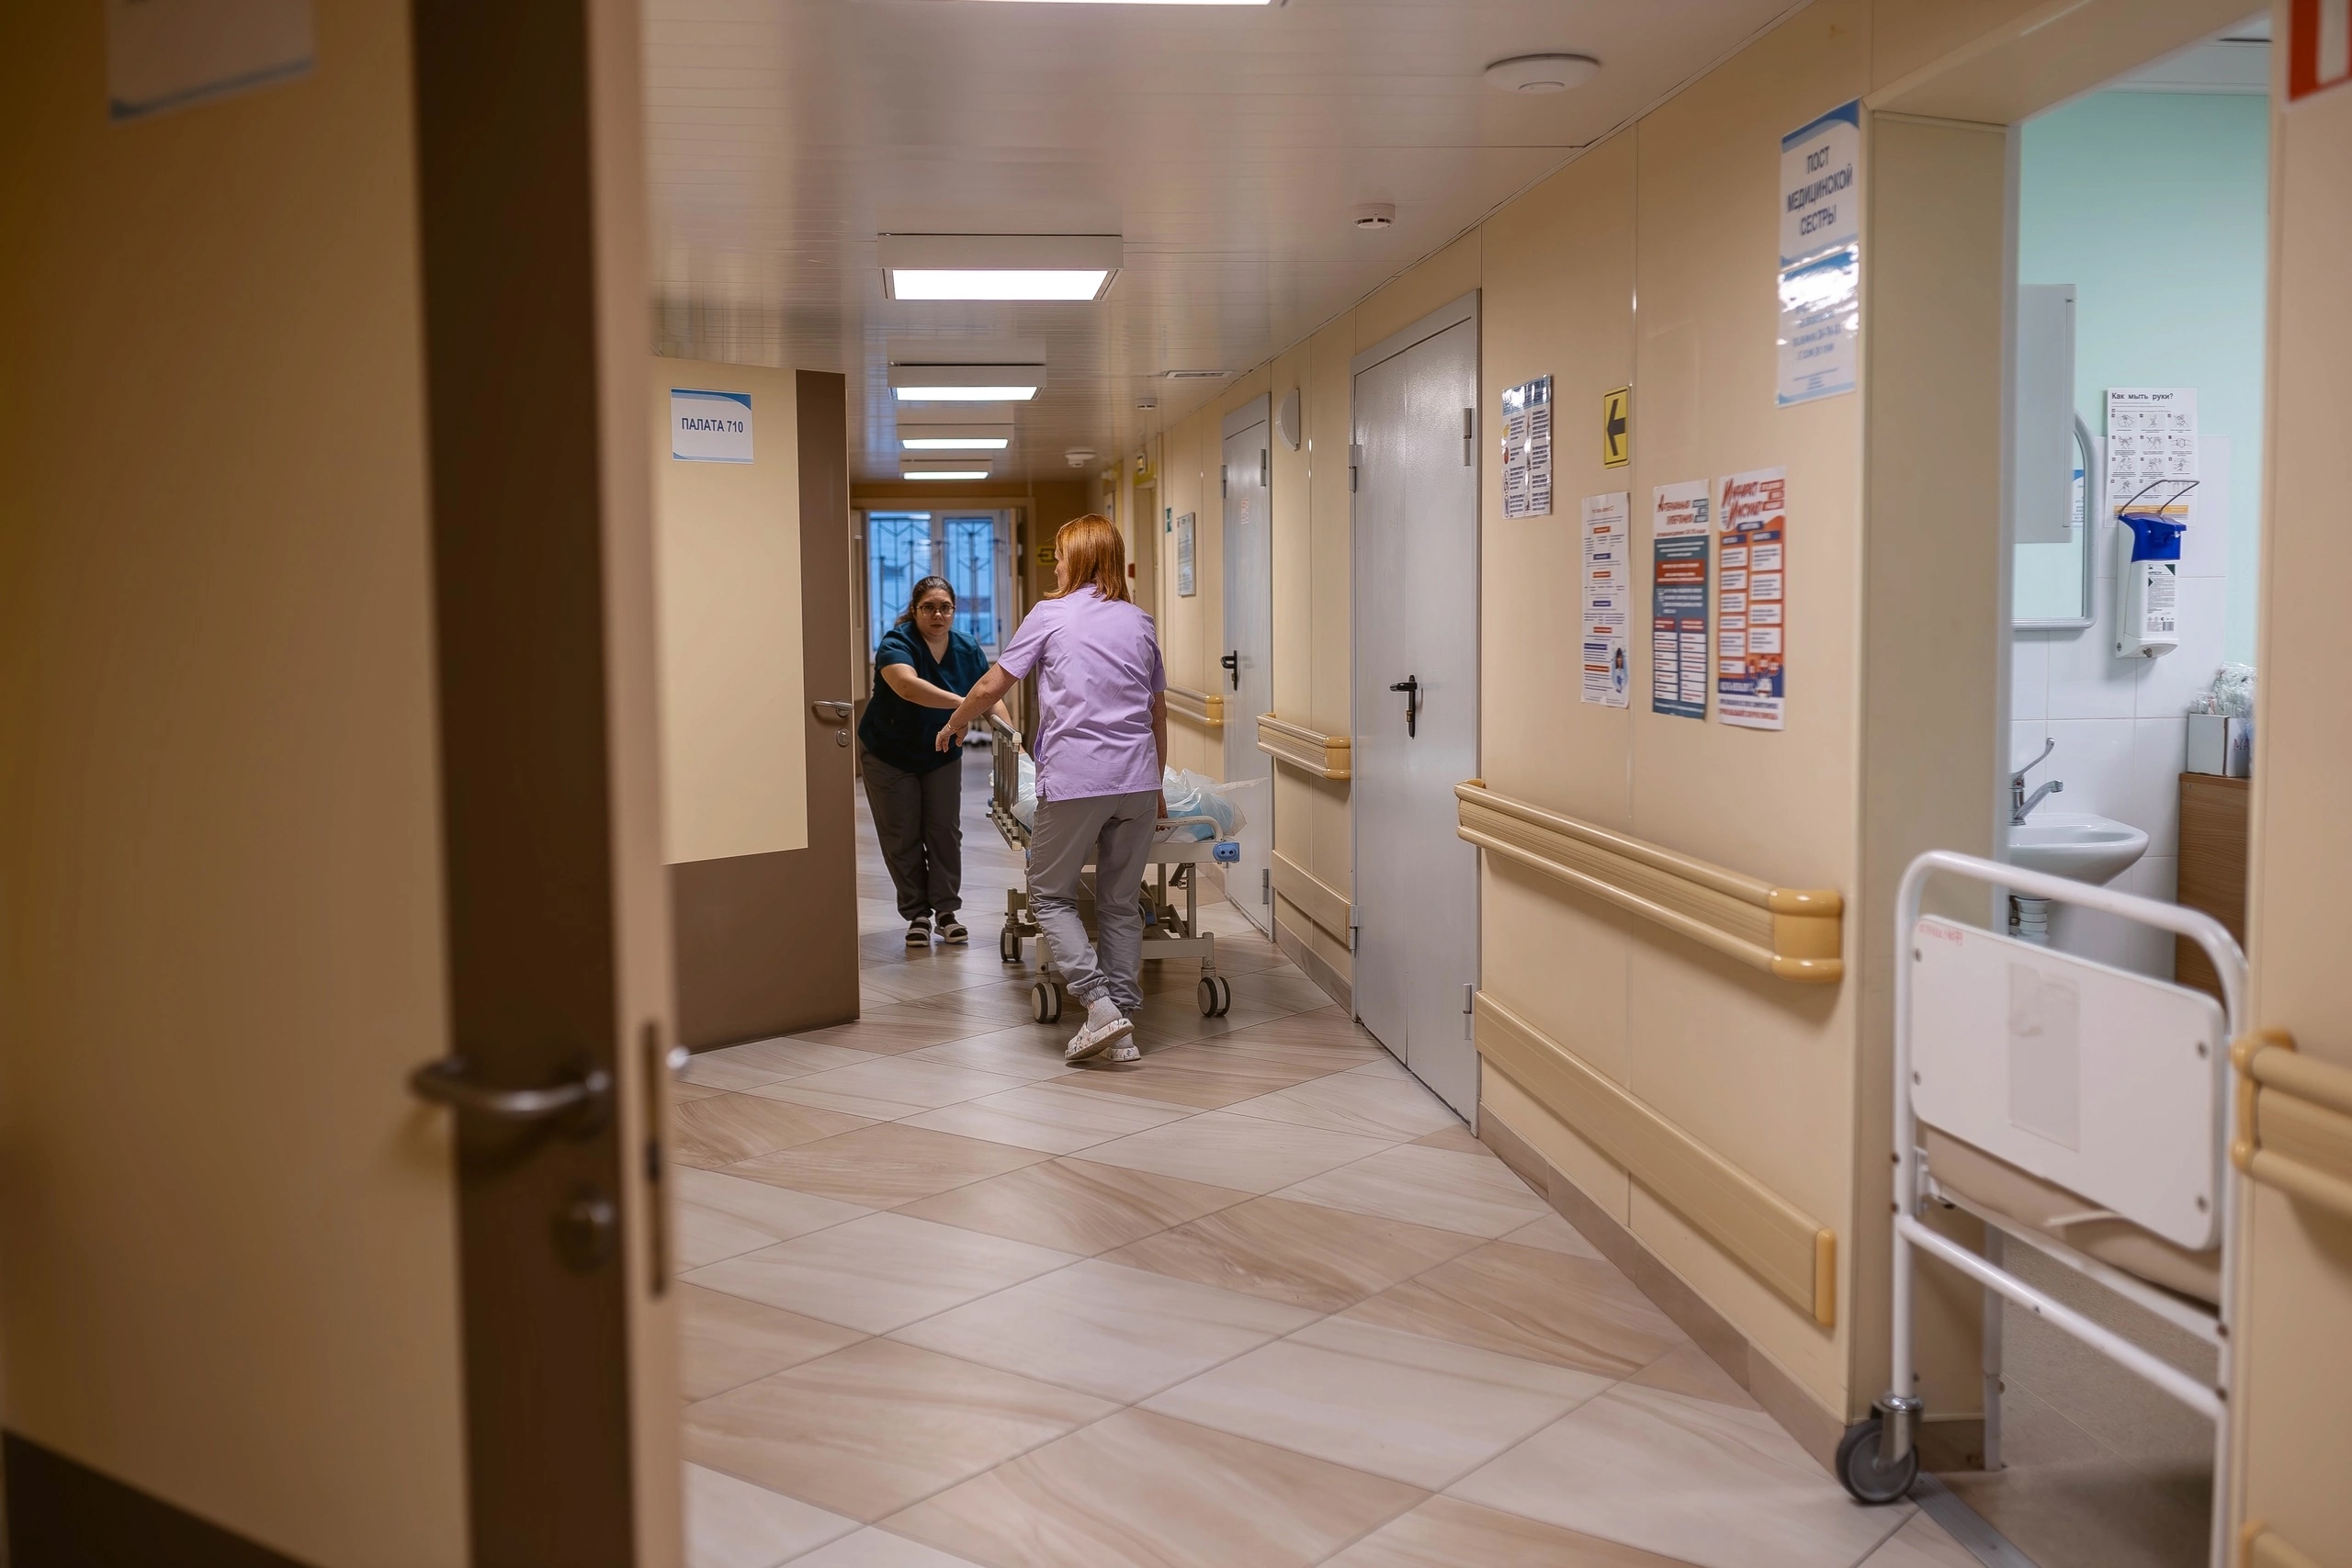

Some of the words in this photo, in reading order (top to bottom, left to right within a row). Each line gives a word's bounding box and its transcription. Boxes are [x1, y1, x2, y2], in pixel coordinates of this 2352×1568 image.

[1806, 145, 1830, 175] ПОСТ
[1786, 163, 1853, 213] МЕДИЦИНСКОЙ
[1800, 203, 1838, 236] СЕСТРЫ
[2152, 392, 2174, 401] руки?
[681, 417, 725, 433] ПАЛАТА
[727, 420, 744, 434] 710
